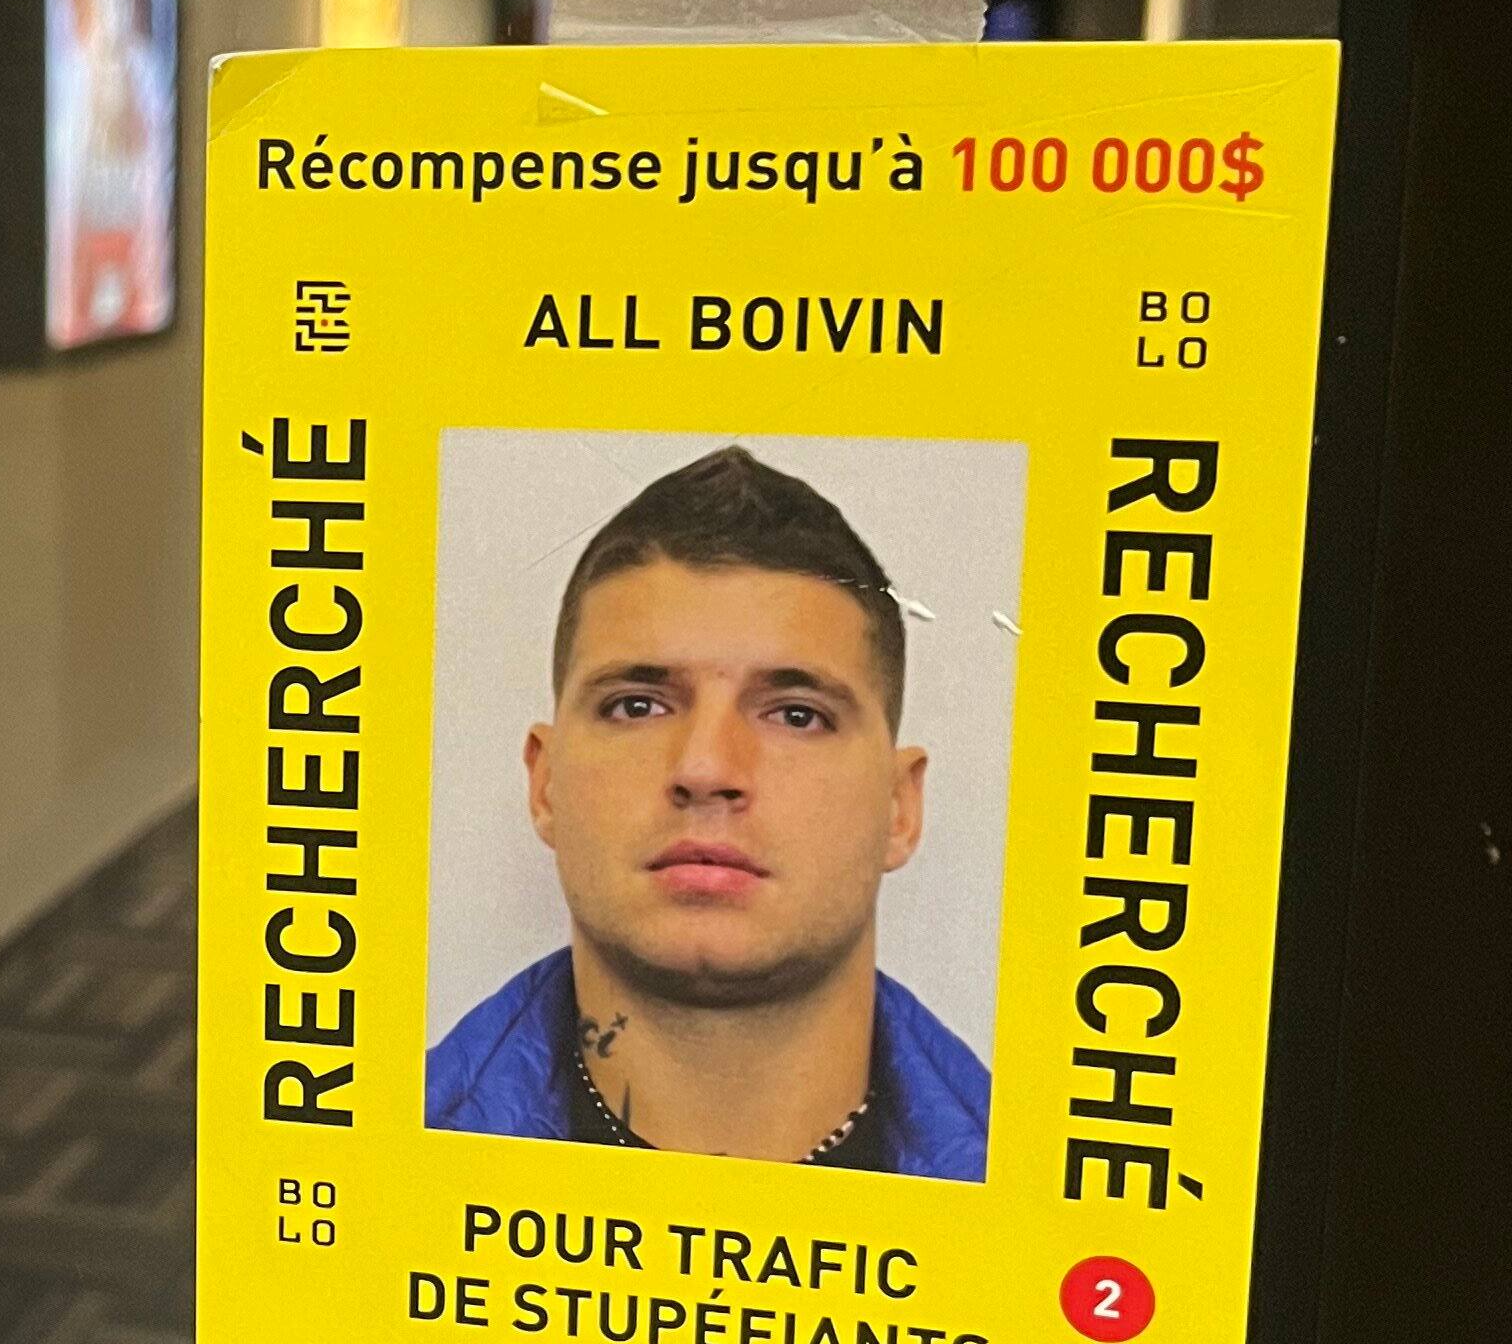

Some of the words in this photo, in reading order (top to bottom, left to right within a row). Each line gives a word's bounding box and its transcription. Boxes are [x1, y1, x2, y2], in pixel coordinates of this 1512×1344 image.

[258, 133, 661, 203] Récompense
[678, 133, 923, 205] jusqu'à
[952, 138, 1067, 193] 100
[1091, 131, 1265, 203] 000$
[524, 294, 660, 350] ALL
[690, 296, 944, 355] BOIVIN
[1140, 290, 1211, 324] BO
[241, 417, 367, 1128] RECHERCHÉ
[1062, 438, 1219, 1211] RECHERCHÉ
[278, 1177, 336, 1209] BO
[464, 1203, 643, 1271] POUR
[668, 1224, 918, 1299] TRAFIC
[408, 1271, 490, 1328] DE
[1093, 1279, 1122, 1318] 2
